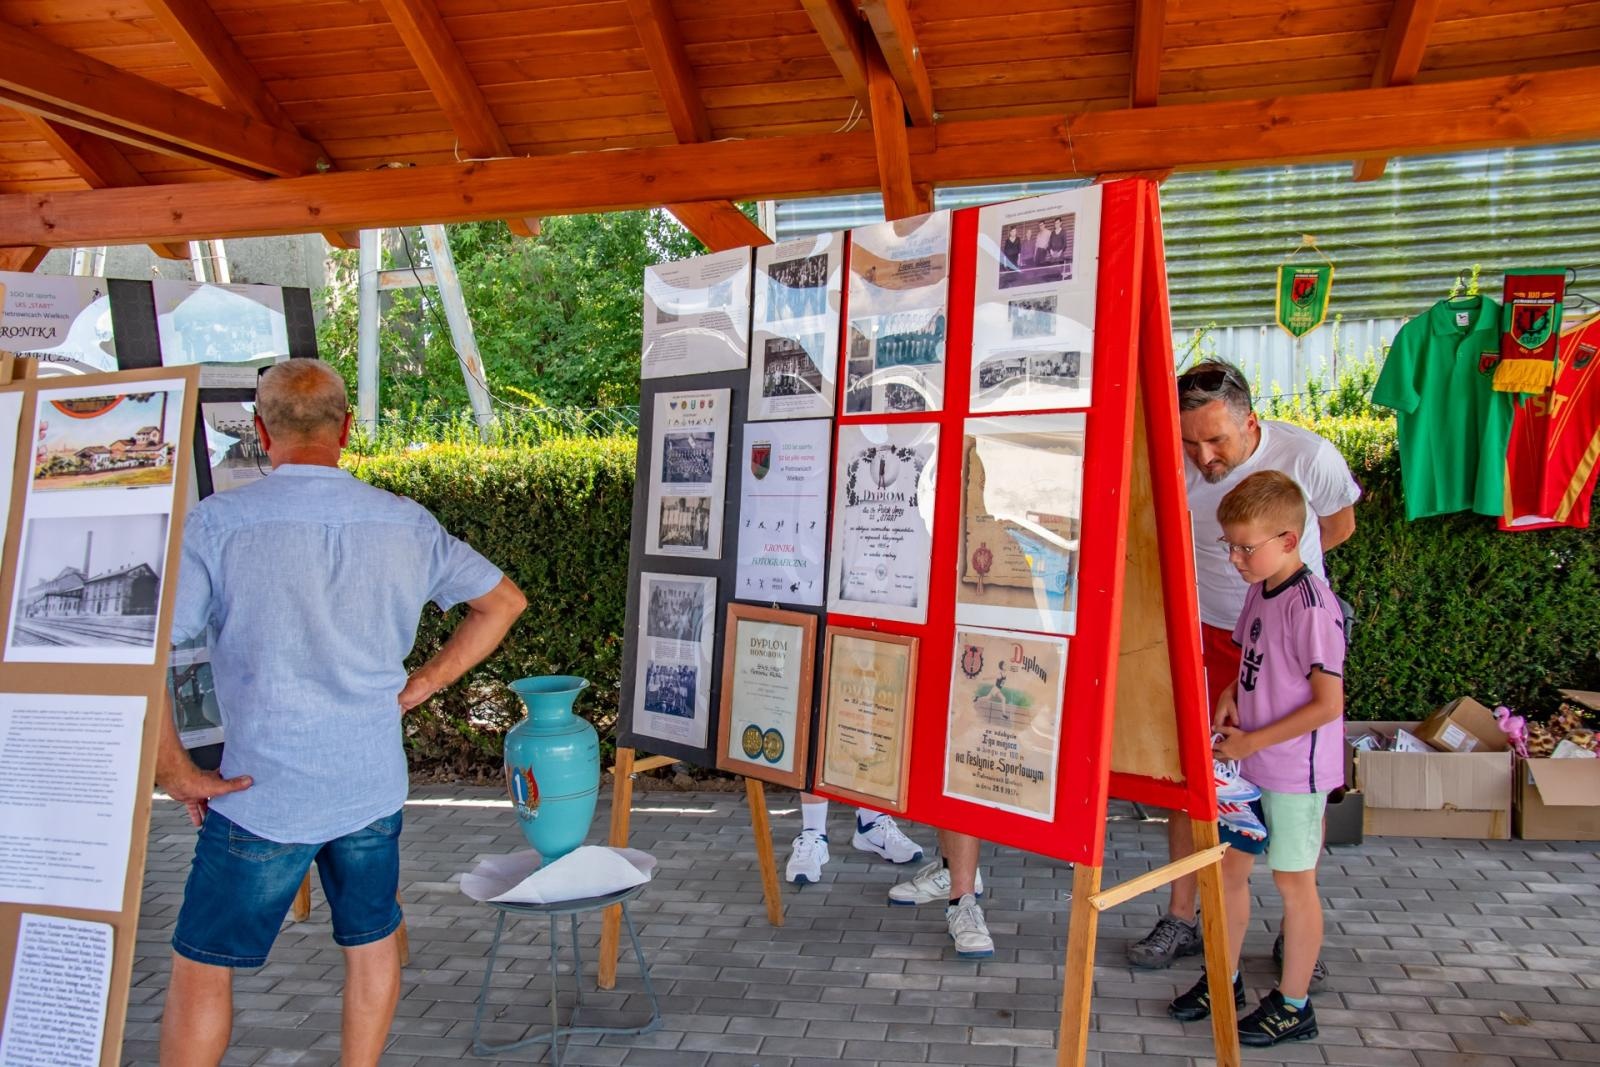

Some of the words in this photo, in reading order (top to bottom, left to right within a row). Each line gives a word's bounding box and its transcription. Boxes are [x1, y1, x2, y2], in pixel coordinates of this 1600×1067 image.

[0, 326, 57, 338] RONIKA
[863, 489, 905, 501] DYPLOM
[763, 543, 795, 553] KRONIKA
[751, 557, 807, 568] FOTOGRAFICZNA
[750, 637, 788, 651] DYPLOM
[1009, 642, 1048, 684] Dyplom
[955, 751, 965, 764] na
[966, 750, 995, 772] Festynie
[996, 757, 1045, 784] Sportowym
[1277, 1016, 1300, 1032] FILA
